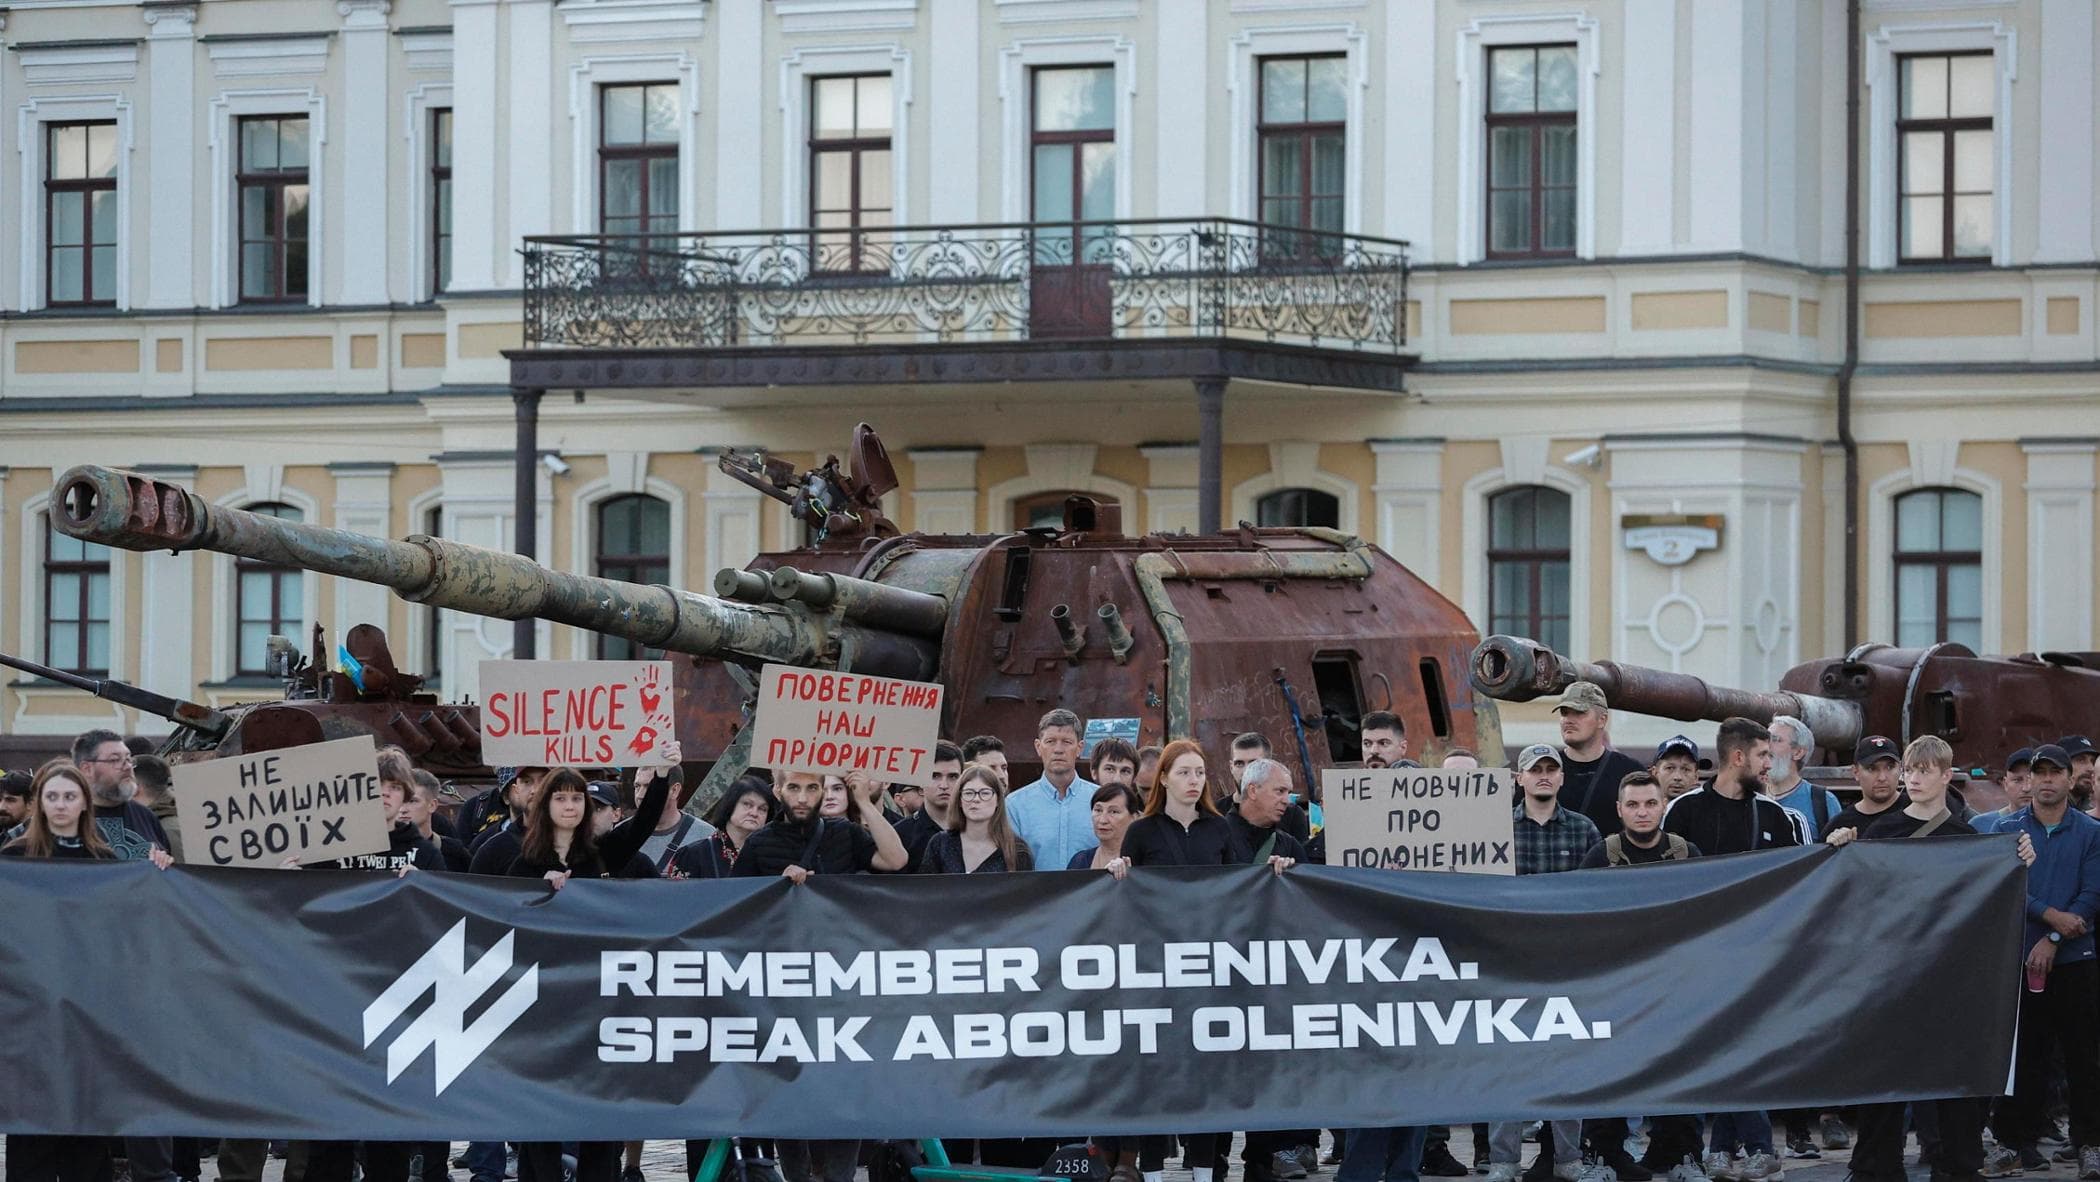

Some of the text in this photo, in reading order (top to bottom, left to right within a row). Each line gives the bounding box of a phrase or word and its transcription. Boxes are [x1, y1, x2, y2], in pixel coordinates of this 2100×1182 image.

[776, 673, 938, 709] ПОВЕРНЕННЯ
[486, 683, 628, 737] SILENCE
[816, 709, 876, 737] НАШ
[545, 734, 613, 764] KILLS
[767, 736, 926, 775] ПРІОРИТЕТ
[239, 756, 282, 788] НЕ
[1342, 772, 1499, 800] НЕ МОВЧІТЬ
[202, 772, 381, 829] ЗАЛИШАЙТЕ
[1388, 809, 1440, 833] ПРО
[209, 815, 346, 865] СВОЇХ
[1343, 841, 1509, 869] ПОЛОНЕНИХ
[600, 938, 1479, 997] REMEMBER OLENIVKA.
[597, 997, 1611, 1063] SPEAK ABOUT OLENIVKA.
[1055, 1159, 1089, 1173] 2358
